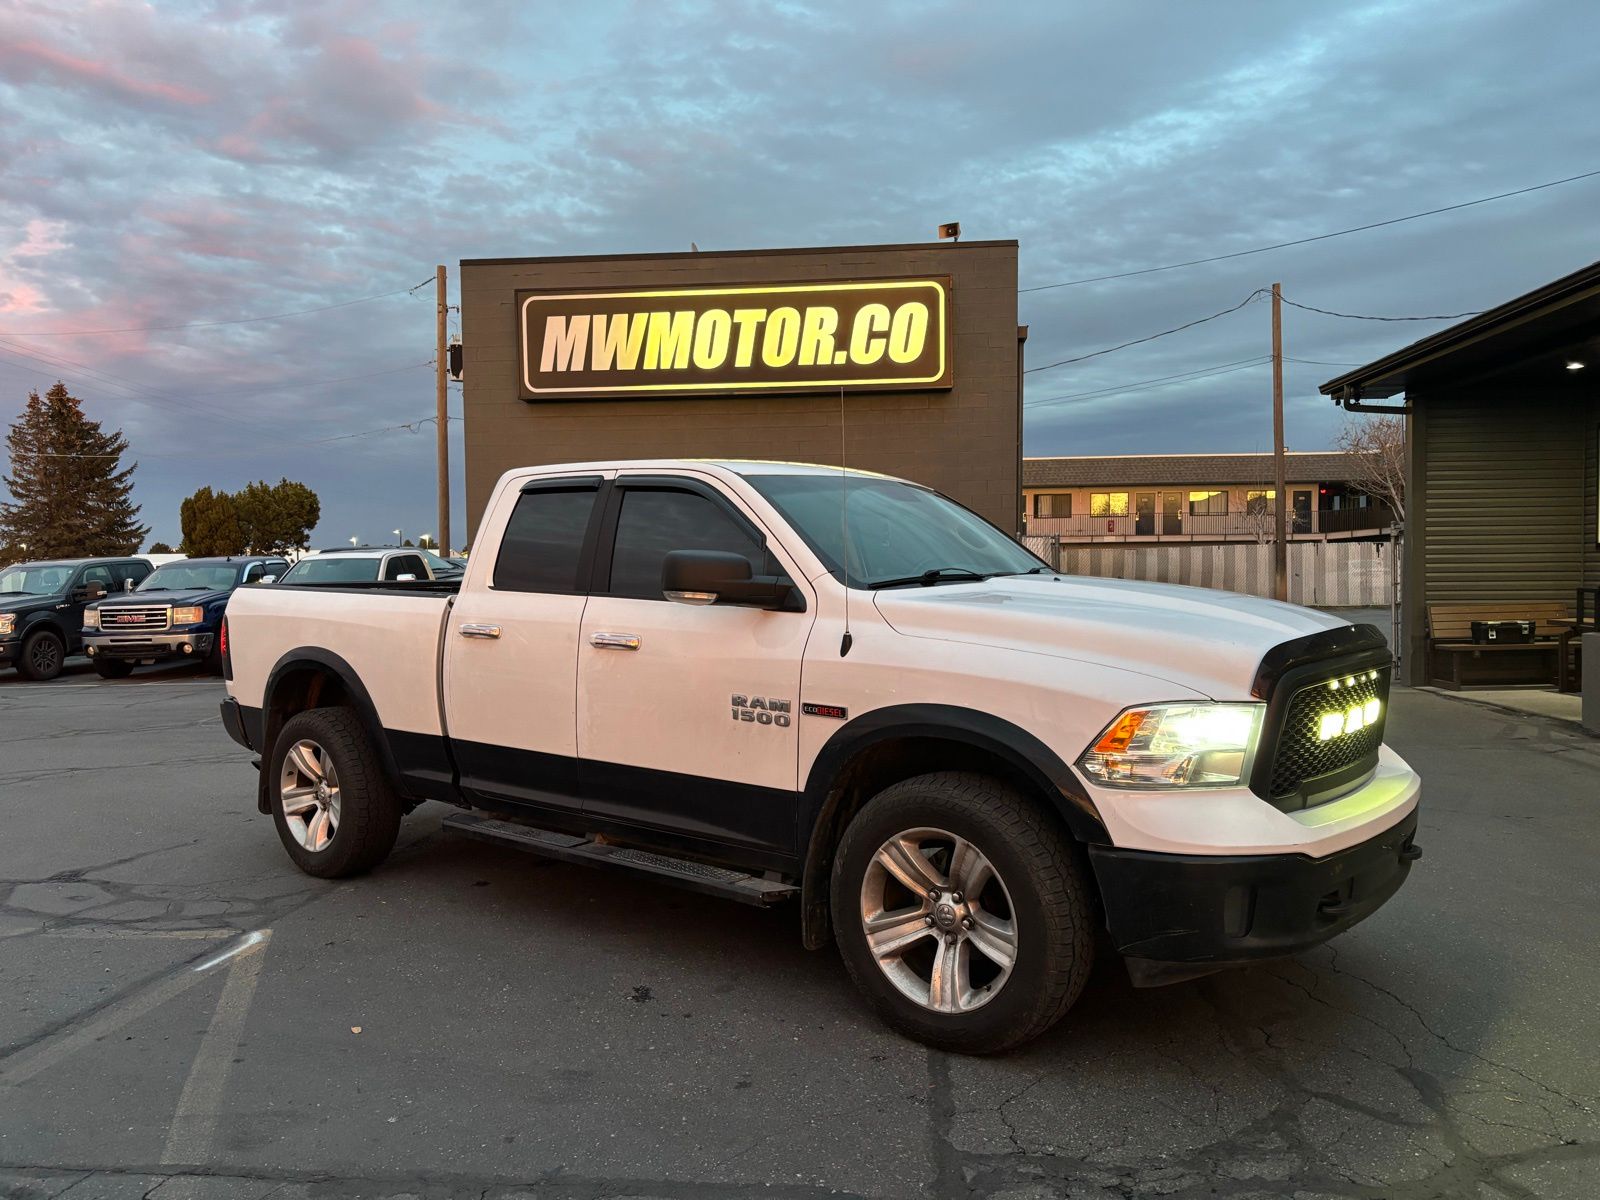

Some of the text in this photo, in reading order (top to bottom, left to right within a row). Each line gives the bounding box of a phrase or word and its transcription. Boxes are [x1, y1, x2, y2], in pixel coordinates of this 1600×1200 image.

[540, 302, 929, 372] MWMOTOR.CO
[731, 693, 791, 713] RAM
[731, 708, 791, 727] 1500
